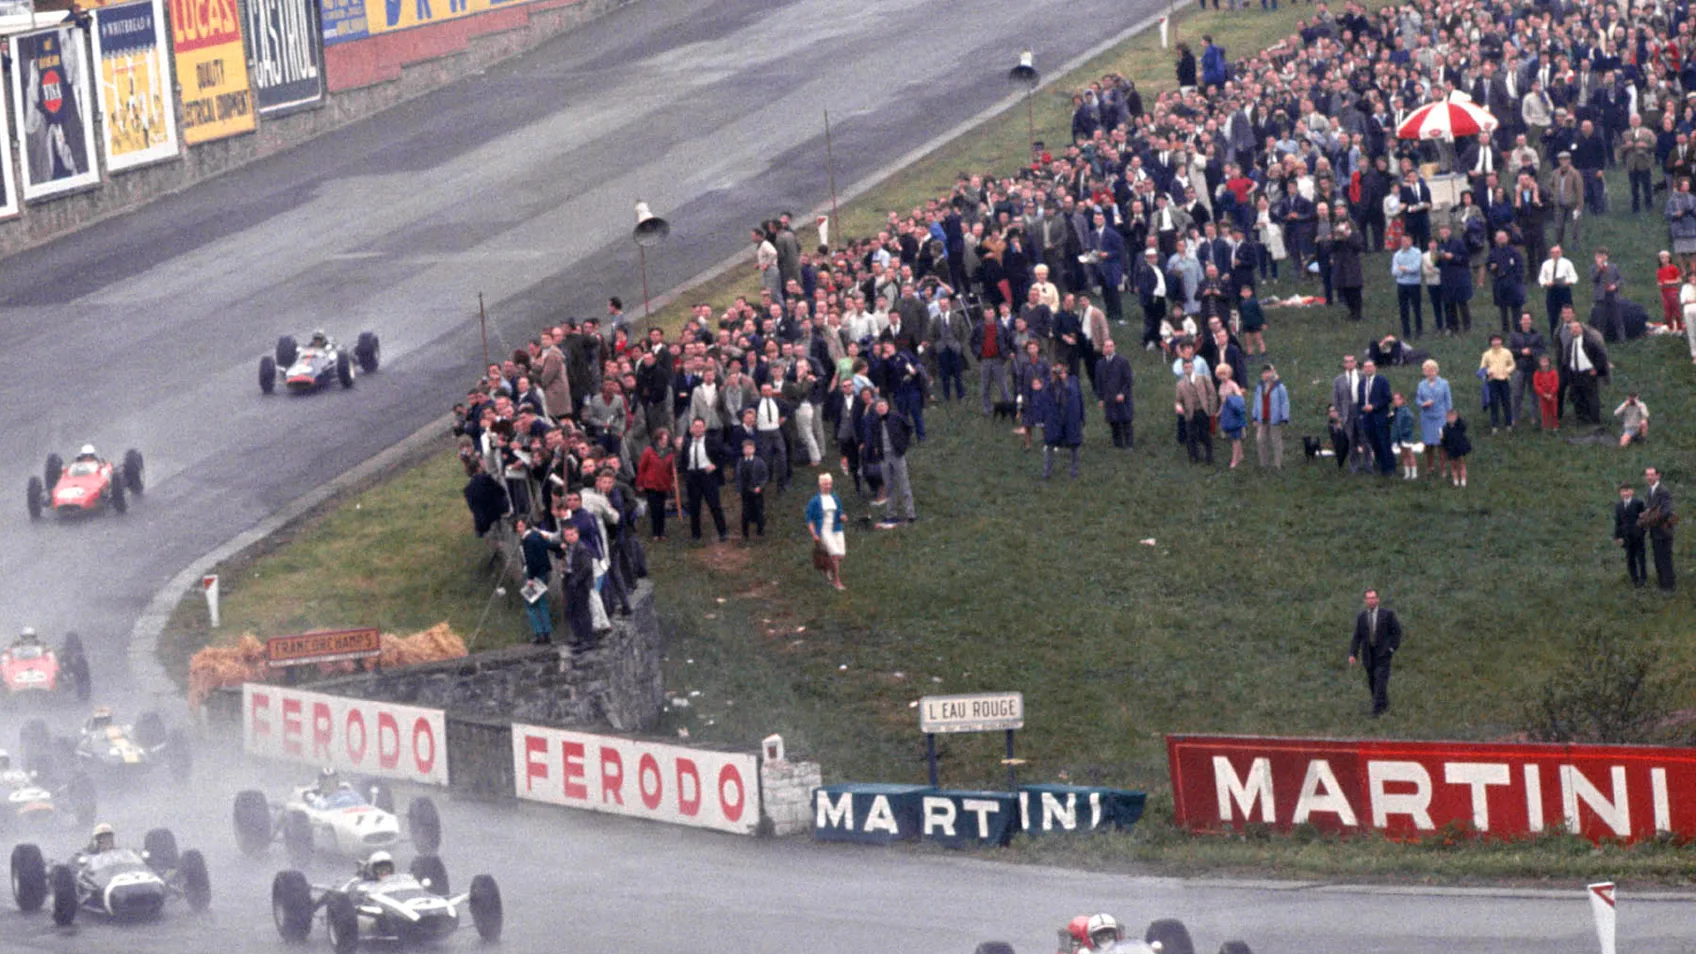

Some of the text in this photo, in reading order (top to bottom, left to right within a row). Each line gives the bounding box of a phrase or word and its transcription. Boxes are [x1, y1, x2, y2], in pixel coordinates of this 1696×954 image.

[171, 0, 236, 43] LUCAS
[247, 0, 316, 88] CASTROL
[274, 633, 372, 655] FRANCORCHAMPS
[252, 692, 435, 774] FERODO
[942, 701, 965, 719] EAU
[972, 699, 1016, 717] ROUGE
[525, 735, 745, 822] FERODO
[1212, 756, 1672, 837] MARTINI
[816, 790, 1101, 838] MARTINI
